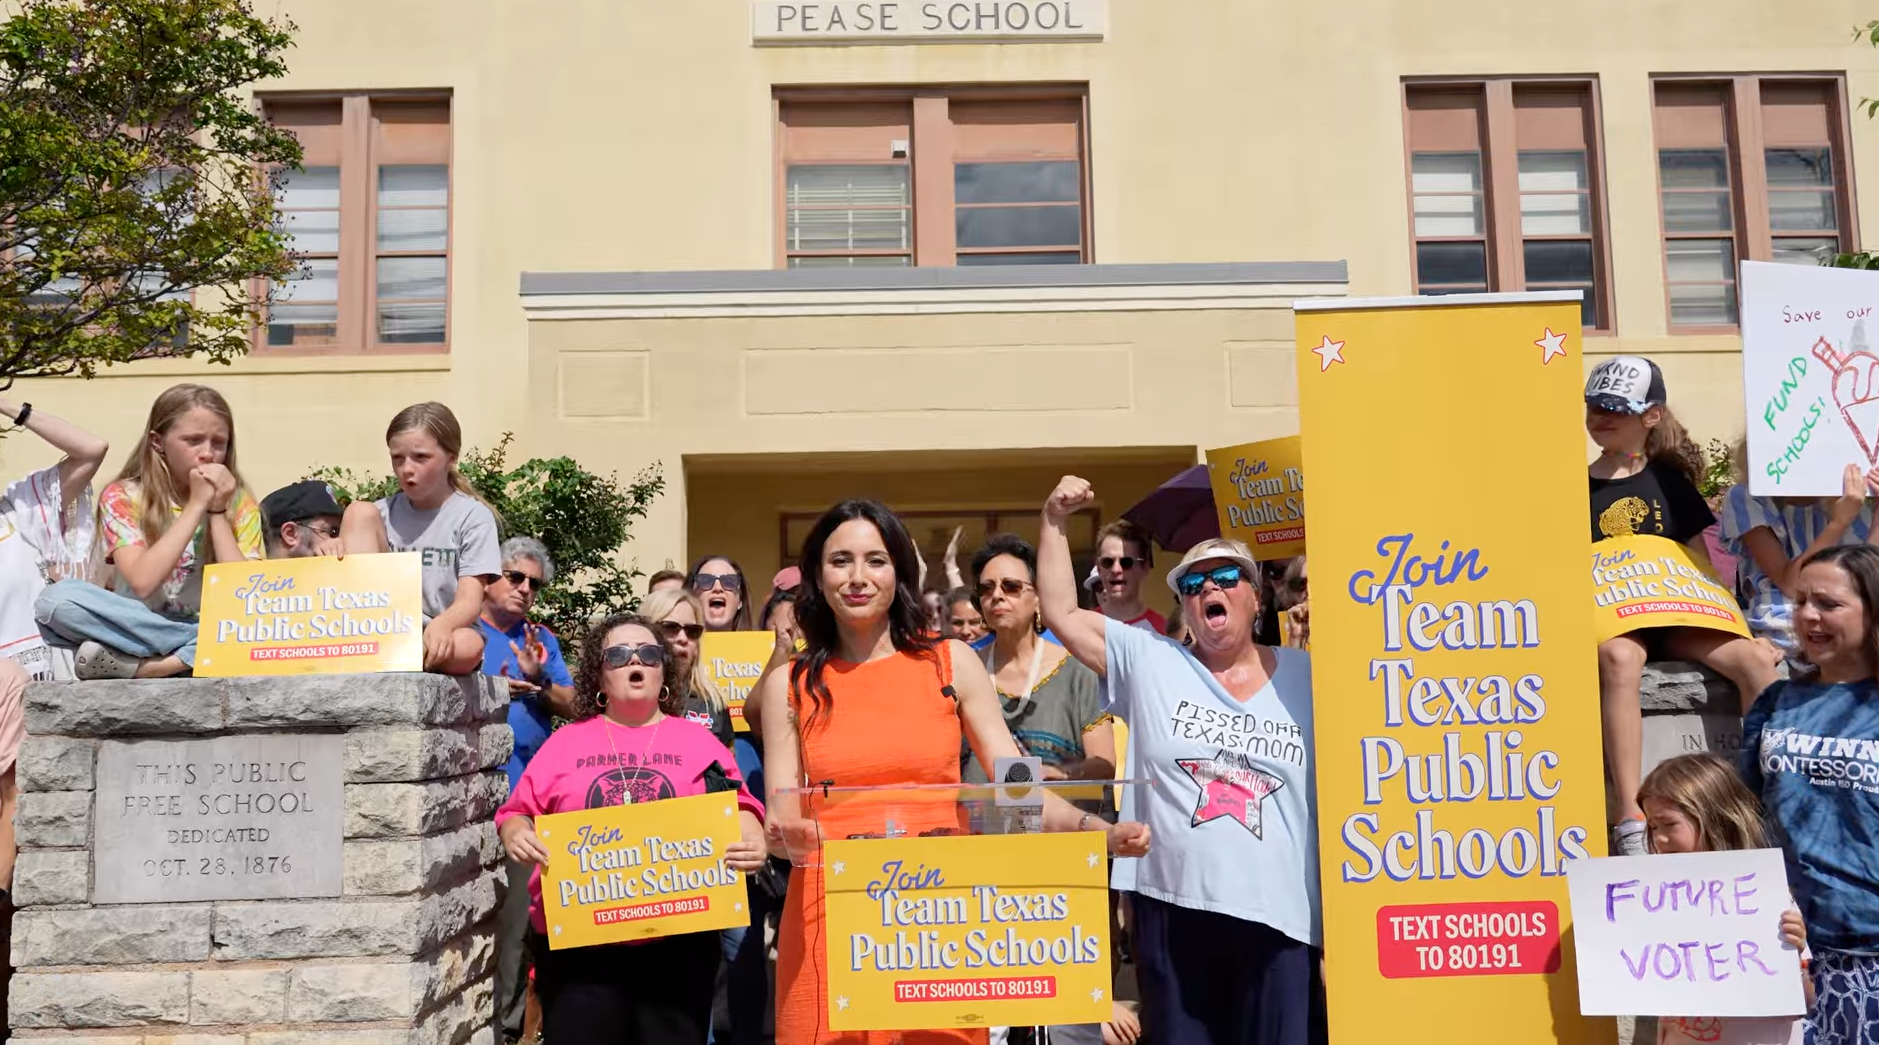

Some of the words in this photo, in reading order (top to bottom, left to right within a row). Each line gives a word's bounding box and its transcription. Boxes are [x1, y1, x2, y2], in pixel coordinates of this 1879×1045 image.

[776, 3, 898, 32] PEASE
[922, 1, 1083, 31] SCHOOL
[1783, 304, 1823, 323] Save
[1846, 305, 1873, 320] our
[1763, 356, 1808, 432] FUND
[1766, 396, 1826, 485] SCHOOLS!
[1229, 458, 1269, 484] Join
[1233, 475, 1284, 500] Team
[1226, 500, 1285, 528] Public
[1256, 531, 1274, 543] TEXT
[1273, 528, 1304, 541] SCHOOLS
[1348, 532, 1488, 605] Join
[1592, 549, 1636, 572] Join
[1592, 560, 1660, 587] Team
[235, 573, 296, 600] Join
[244, 590, 314, 615] Team
[317, 586, 391, 610] Texas
[1594, 579, 1663, 607] ublic
[1370, 583, 1540, 652] Team
[1618, 604, 1643, 616] TEXT
[1644, 602, 1692, 612] SCHOOLS
[1690, 602, 1703, 613] TO
[1703, 606, 1734, 621] 80191
[216, 615, 305, 643] Public
[309, 610, 414, 640] Schools
[252, 648, 278, 659] TEXT
[278, 646, 326, 658] SCHOOLS
[327, 646, 341, 656] TO
[341, 643, 376, 655] 80191
[711, 658, 763, 678] Texas
[1369, 658, 1546, 727] Texas
[729, 707, 743, 716] 801
[1176, 700, 1256, 734] PISSED
[1246, 737, 1304, 767] MOM
[1682, 734, 1702, 751] IN
[136, 764, 197, 785] THIS
[210, 761, 307, 784] PUBLIC
[576, 752, 638, 769] PARMER
[643, 752, 683, 767] LANE
[1361, 730, 1561, 805] Public
[1809, 777, 1836, 787] Austin
[122, 795, 182, 816] FREE
[198, 792, 314, 816] SCHOOL
[167, 828, 270, 844] DEDICATED
[567, 824, 623, 855] Join
[1342, 806, 1590, 884] Schools
[143, 858, 191, 877] OCT.
[199, 857, 235, 876] 28,
[244, 855, 292, 875] 1876
[574, 844, 642, 873] Team
[643, 835, 714, 864] Texas
[558, 869, 641, 907] Public
[641, 858, 740, 898] Schools
[866, 860, 945, 900] Join
[596, 910, 618, 922] TEXT
[619, 905, 661, 920] SCHOOLS
[662, 904, 674, 915] TO
[675, 900, 706, 914] 80191
[875, 887, 969, 927] Team
[971, 884, 1070, 923] Texas
[1605, 873, 1759, 923] FUTURE
[1389, 915, 1442, 942] TEXT
[1445, 911, 1547, 939] SCHOOLS
[850, 929, 961, 972] Public
[965, 925, 1101, 968] Schools
[1415, 946, 1448, 971] TO
[1448, 943, 1522, 970] 80191
[1620, 940, 1777, 983] VOTER
[897, 983, 928, 999] TEXT
[929, 981, 989, 998] SCHOOLS
[990, 981, 1007, 995] TO
[1008, 979, 1051, 995] 80191
